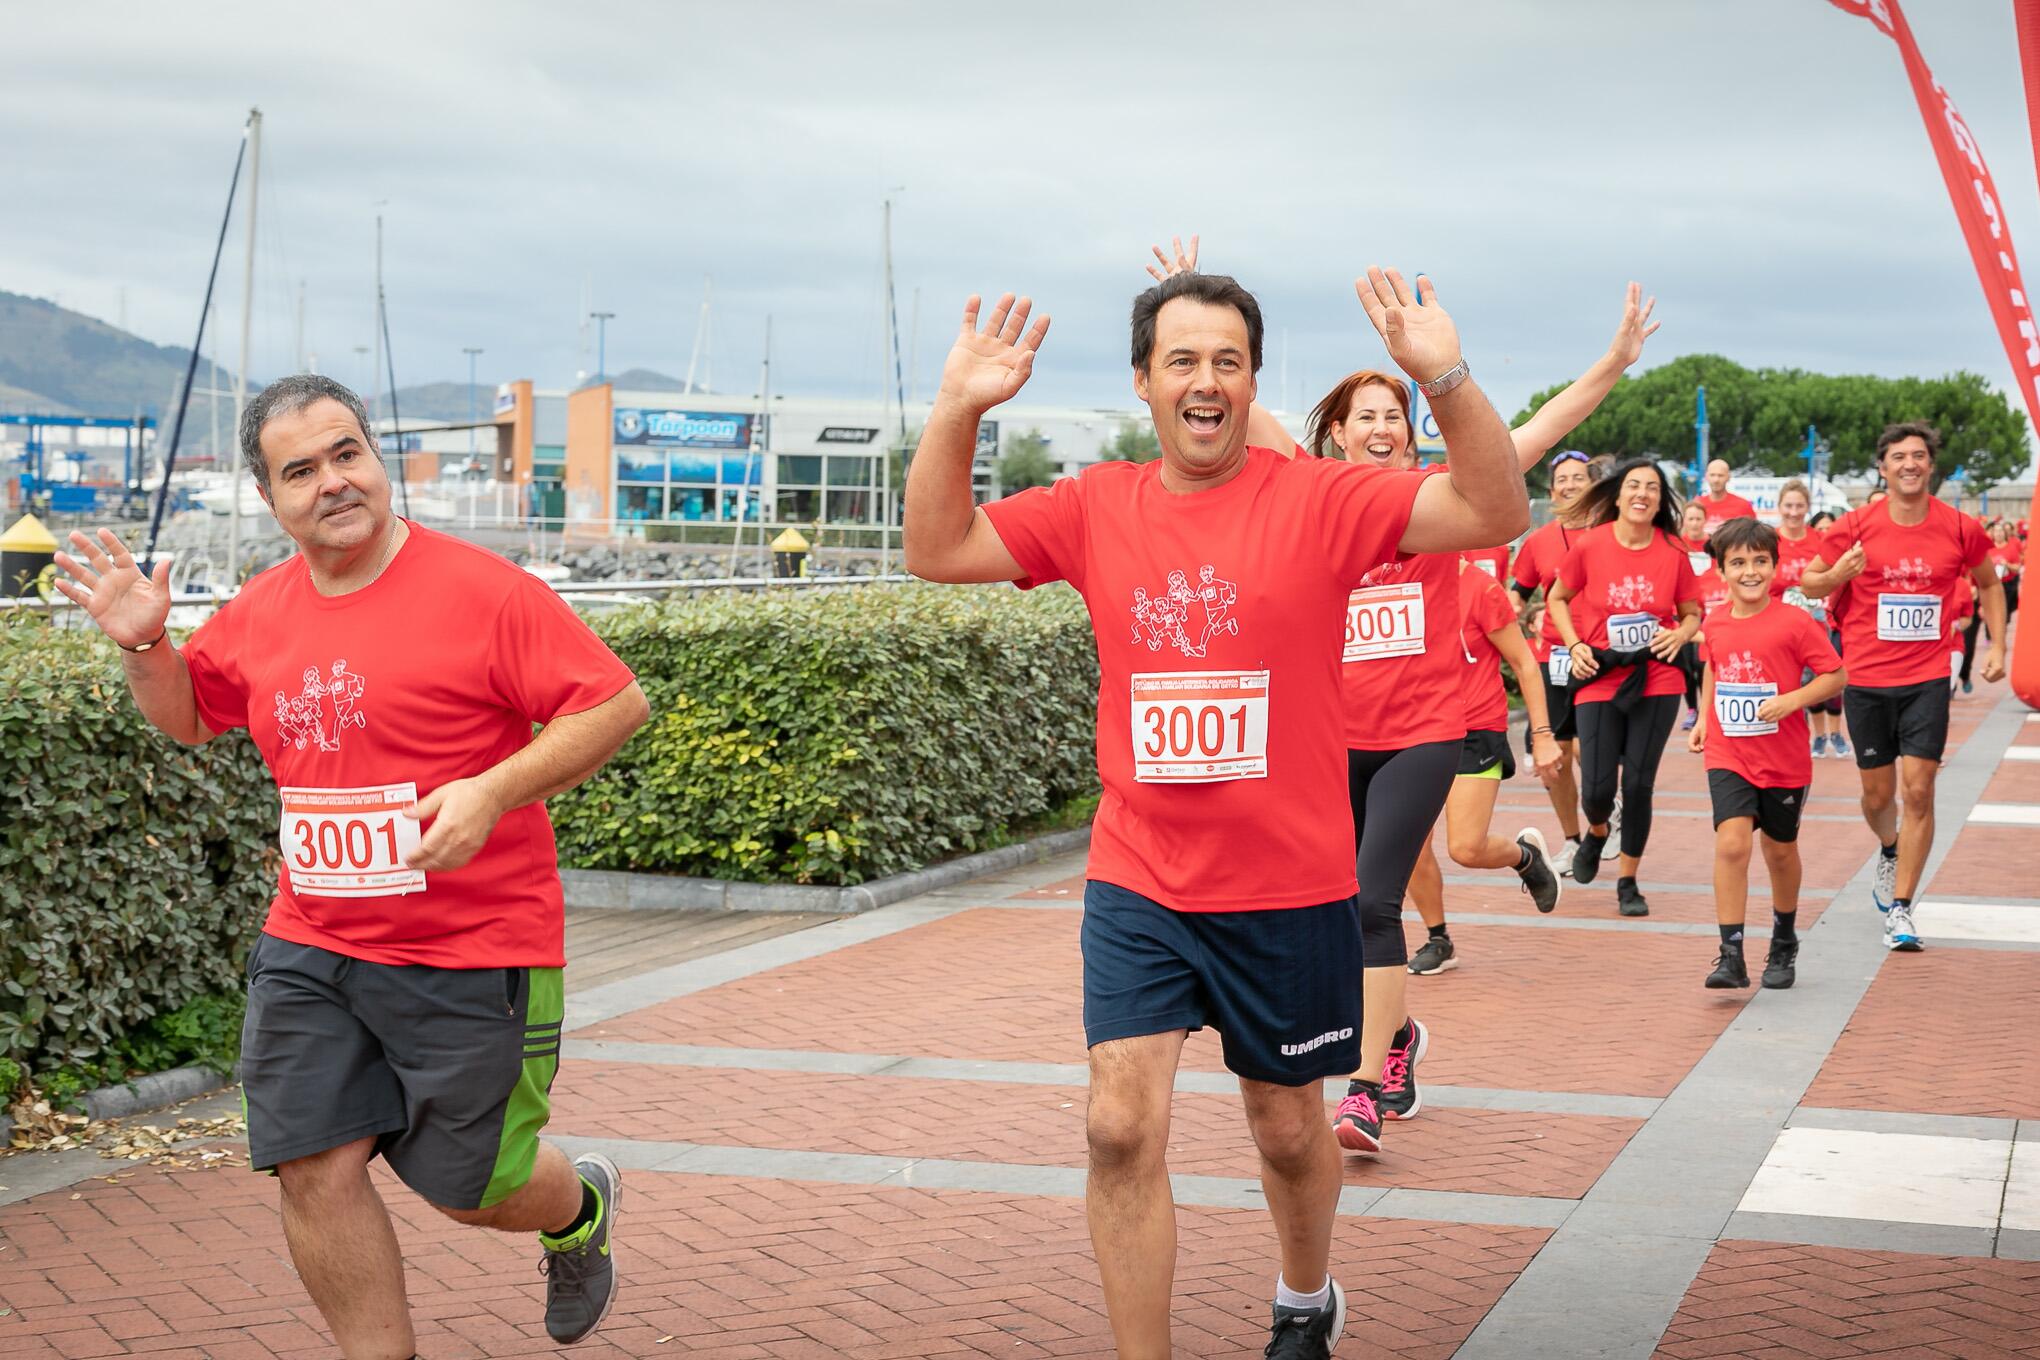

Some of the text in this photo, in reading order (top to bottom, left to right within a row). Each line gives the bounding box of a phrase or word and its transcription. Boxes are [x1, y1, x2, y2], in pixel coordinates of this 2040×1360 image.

[647, 414, 738, 440] Tarpoon
[1887, 607, 1934, 629] 1002
[1144, 704, 1247, 758] 3001
[294, 817, 399, 869] 3001
[1281, 1027, 1353, 1056] UMBRO
